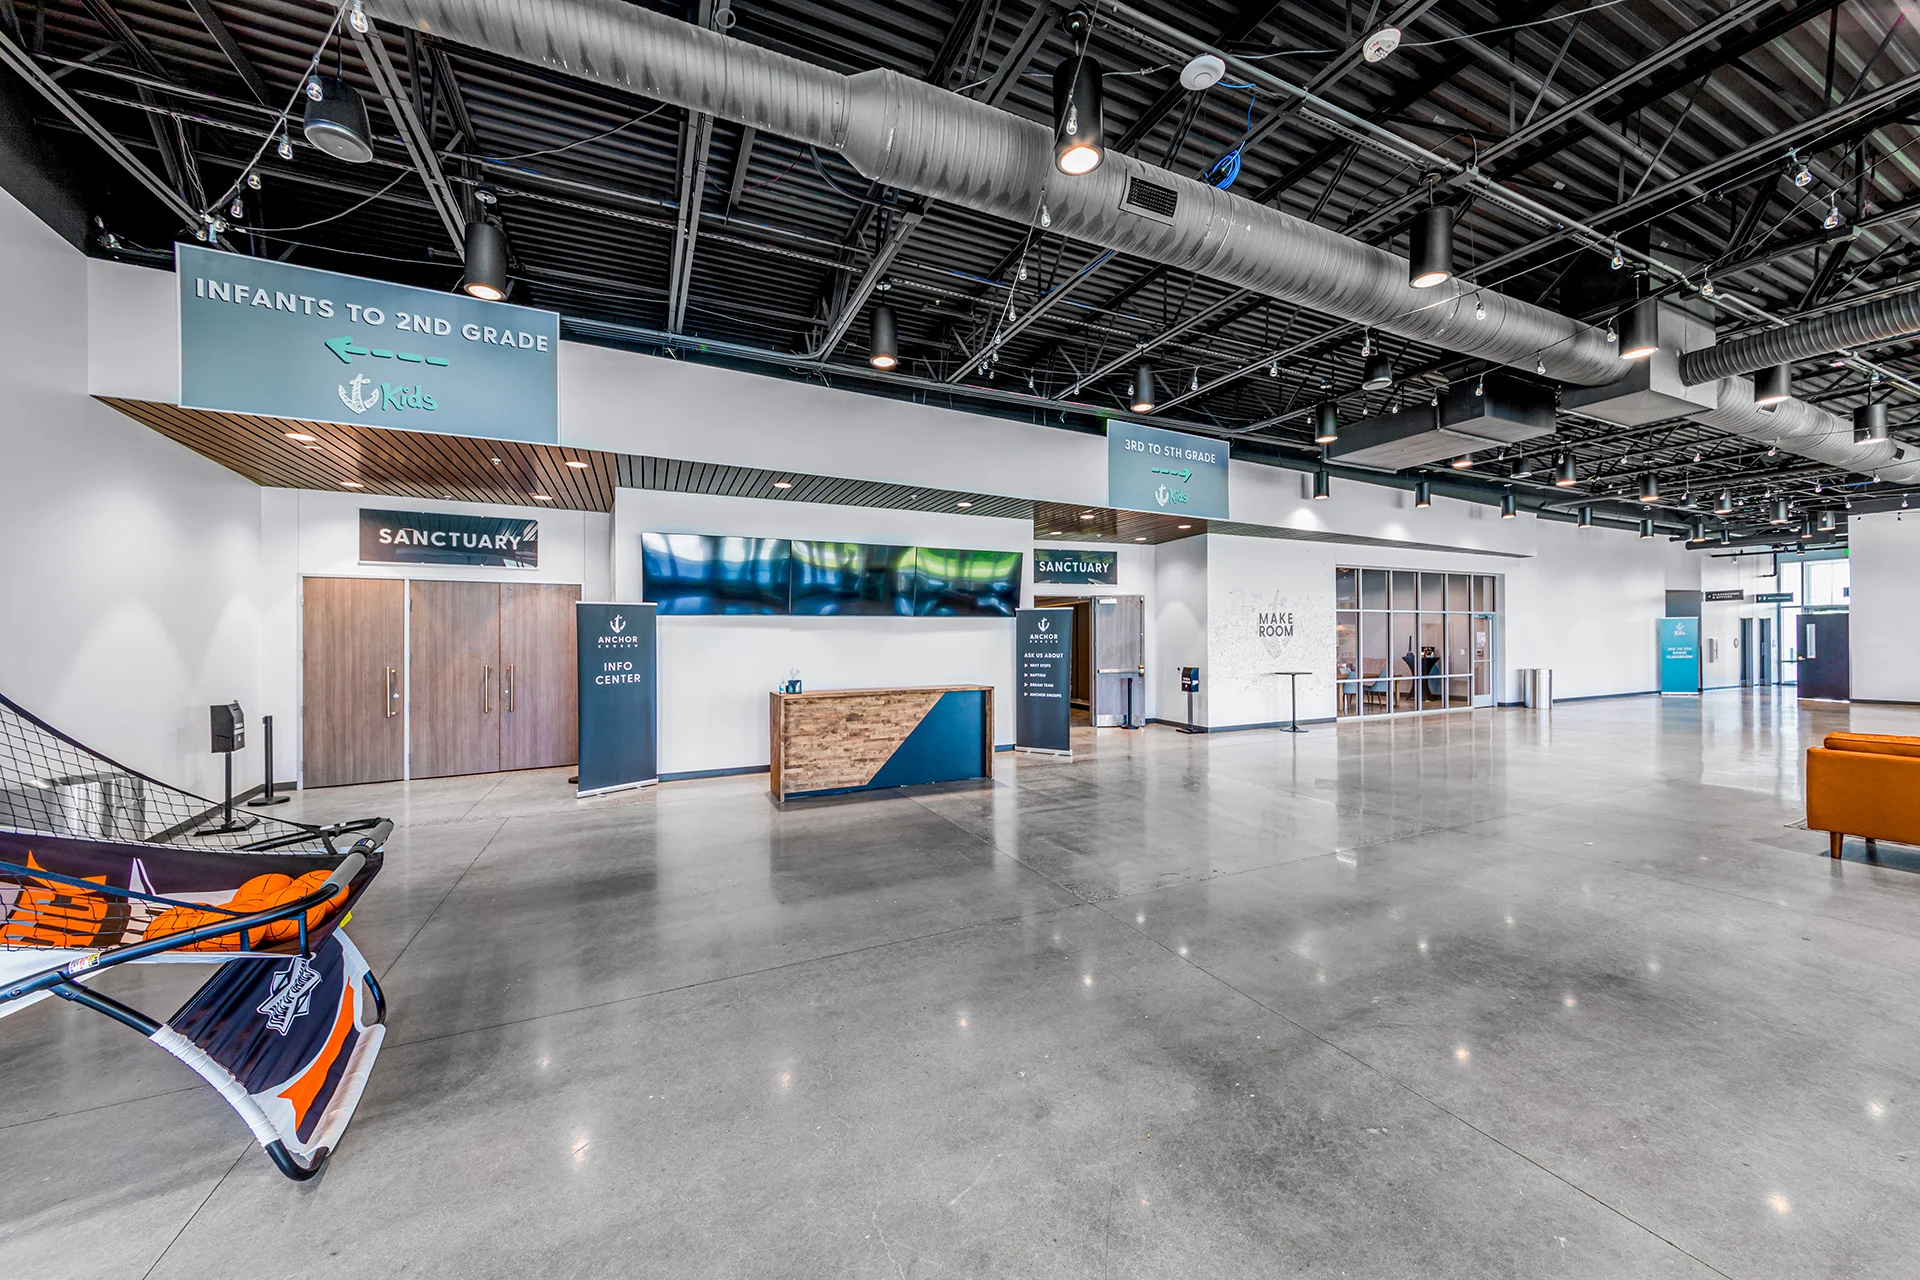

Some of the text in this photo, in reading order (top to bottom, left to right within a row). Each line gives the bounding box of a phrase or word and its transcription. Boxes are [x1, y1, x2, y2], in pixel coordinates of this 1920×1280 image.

[195, 277, 548, 353] INFANTS TO 2ND GRADE
[380, 382, 439, 411] Kids
[1124, 439, 1216, 464] 3RD TO 5TH GRADE
[1169, 489, 1189, 505] Kids
[378, 528, 521, 550] SANCTUARY
[1039, 561, 1110, 574] SANCTUARY
[1259, 612, 1294, 625] MAKE
[1259, 625, 1294, 637] ROOM
[603, 661, 633, 671] INFO
[595, 673, 641, 685] CENTER
